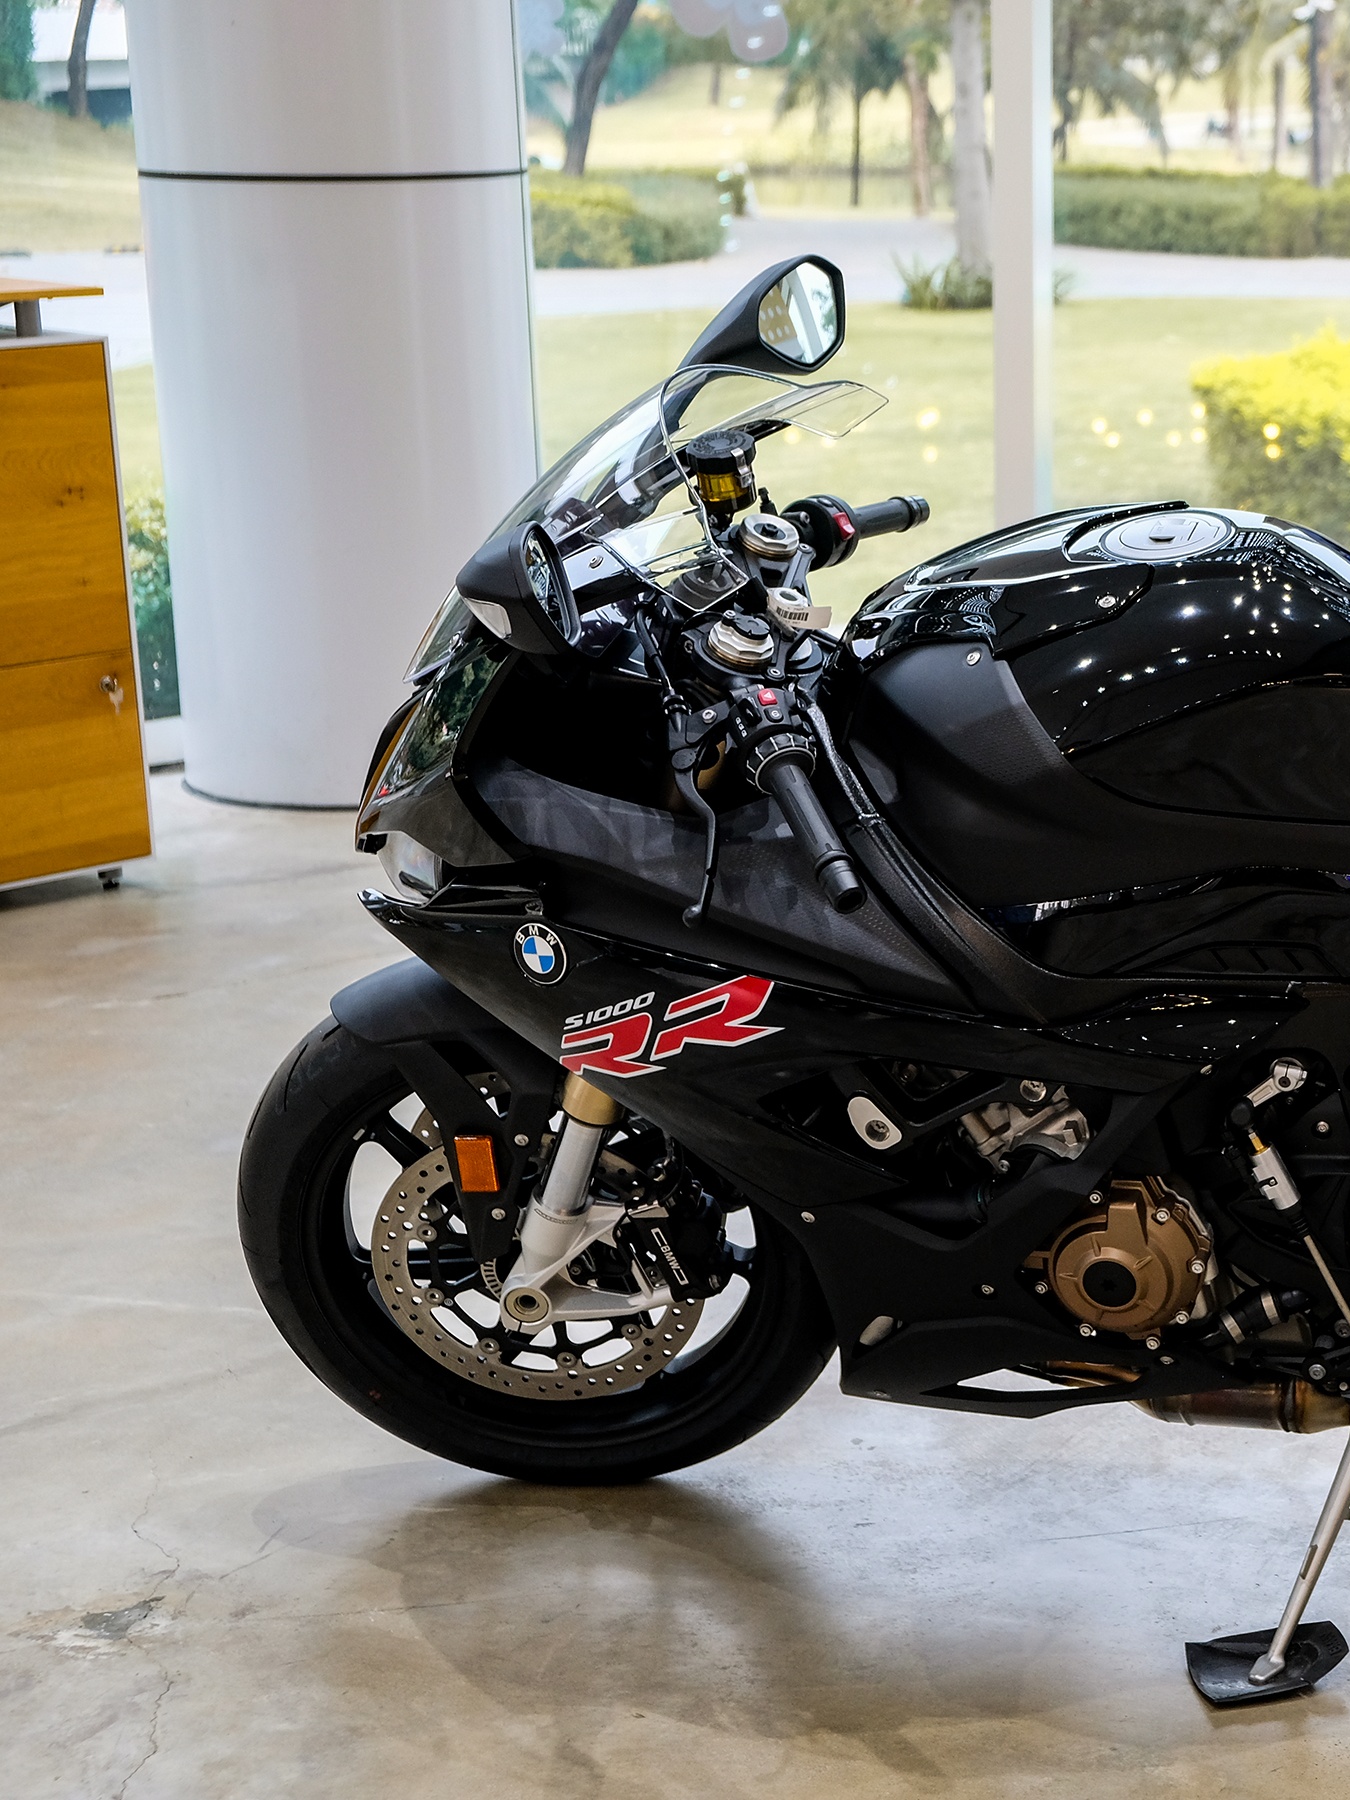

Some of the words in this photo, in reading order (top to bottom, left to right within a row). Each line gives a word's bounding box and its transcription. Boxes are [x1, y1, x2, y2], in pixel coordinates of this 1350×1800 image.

[515, 924, 558, 946] BMW
[559, 974, 786, 1078] RR
[563, 991, 656, 1030] S1000
[660, 1245, 680, 1269] BMW
